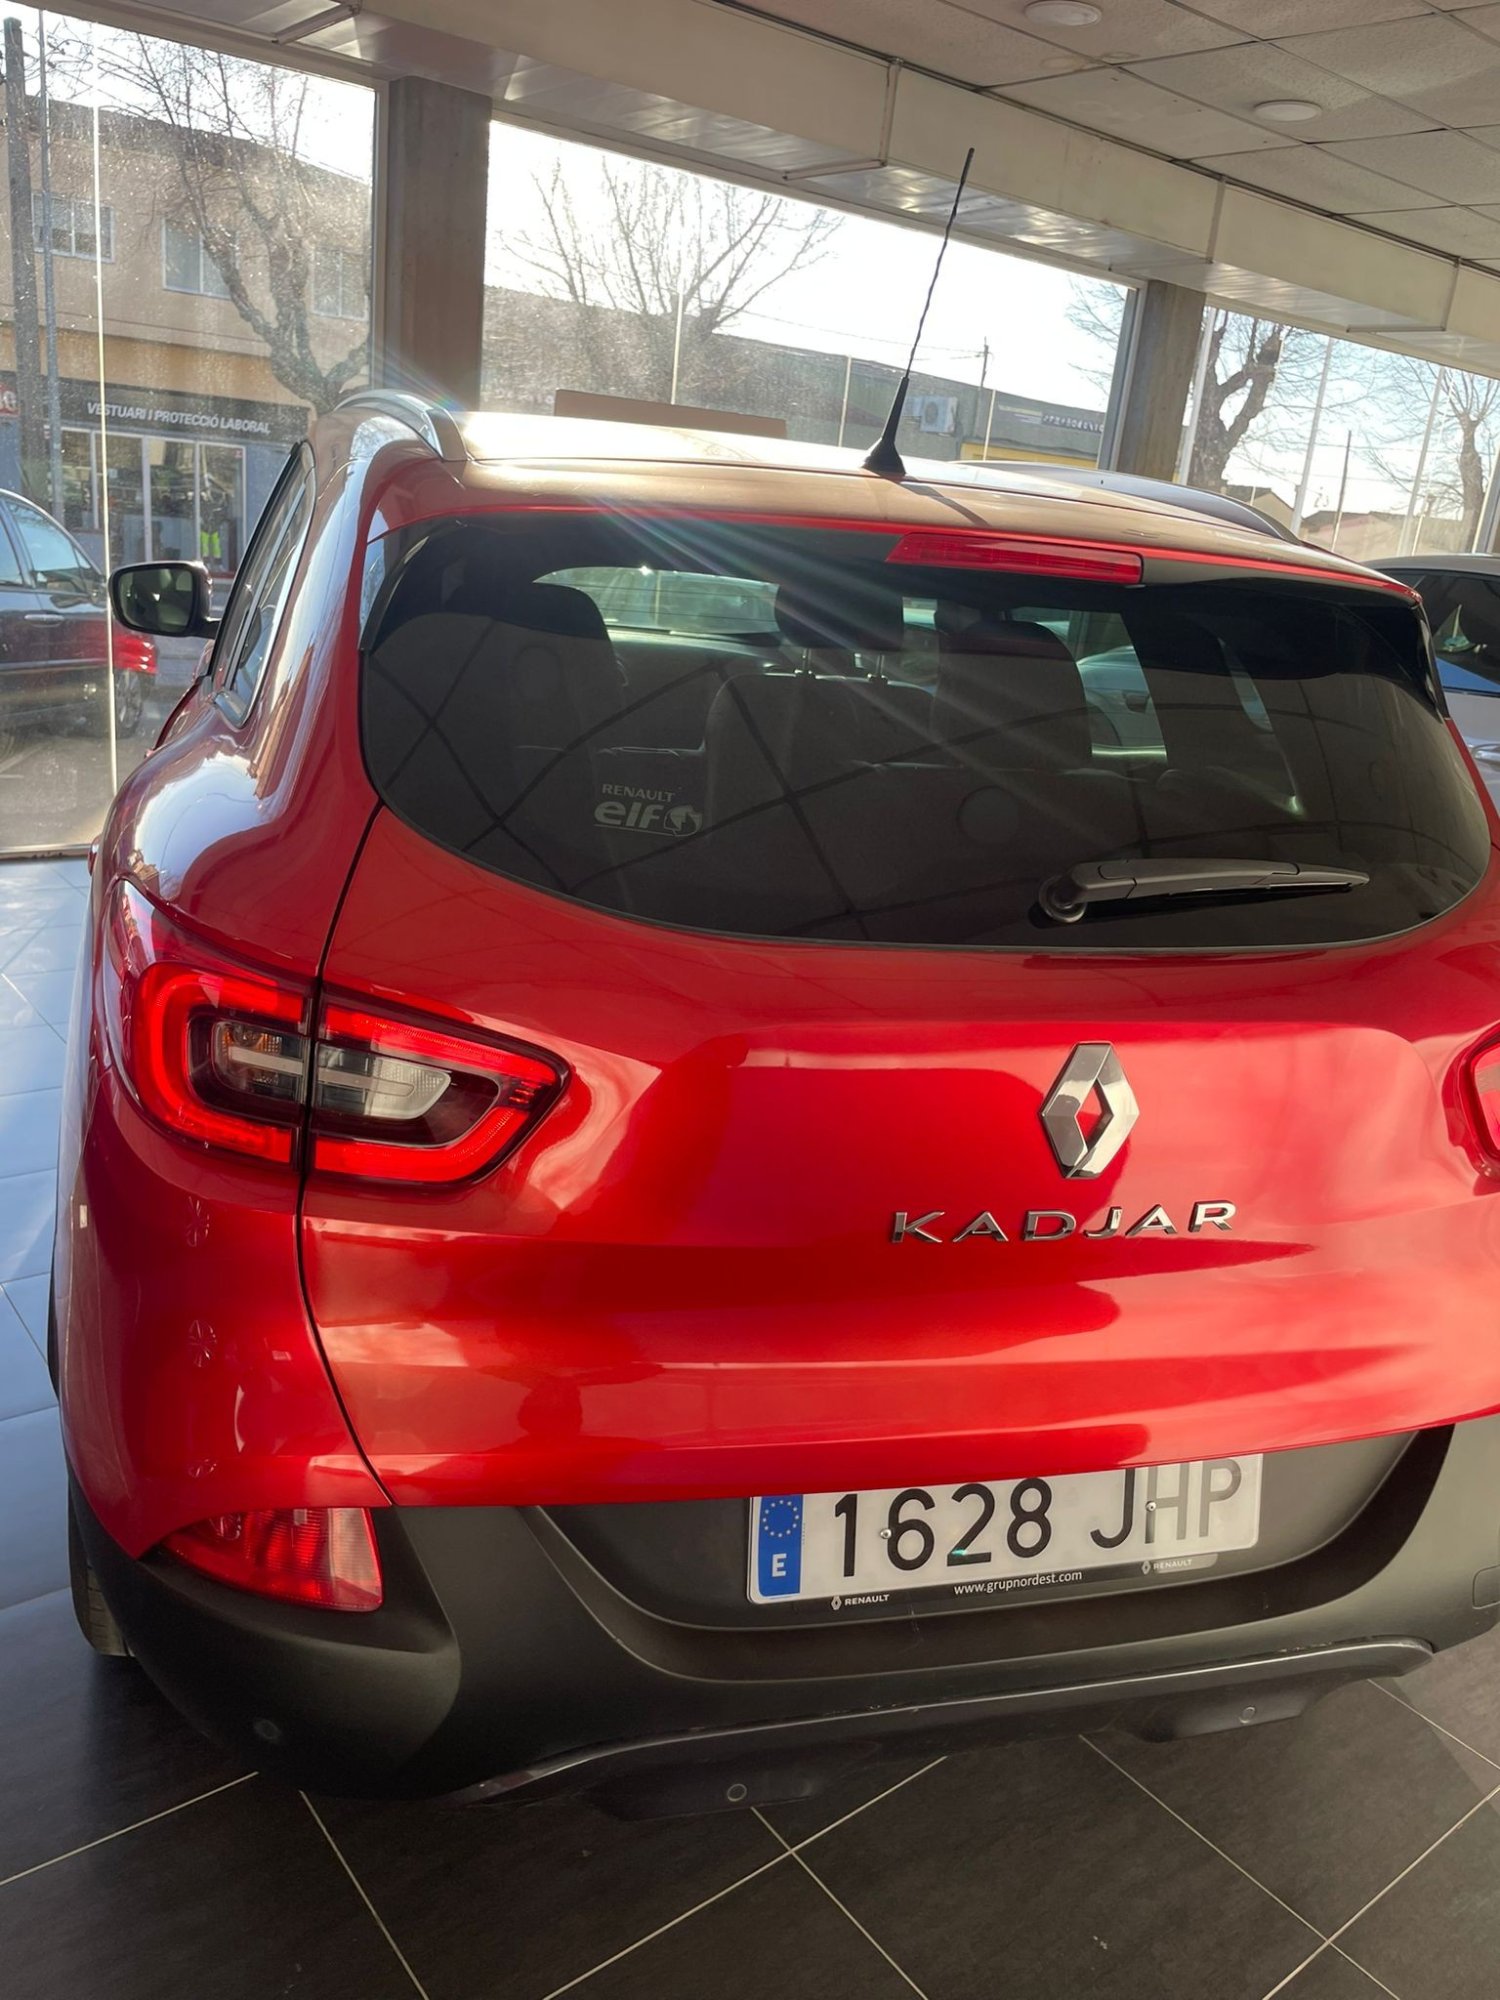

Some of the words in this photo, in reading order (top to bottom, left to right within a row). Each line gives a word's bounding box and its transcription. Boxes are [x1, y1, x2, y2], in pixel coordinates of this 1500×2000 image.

[87, 402, 146, 419] VESTUARI
[154, 410, 218, 427] PROTECCIÓ
[220, 417, 271, 434] LABORAL
[602, 783, 675, 802] RENAULT
[594, 801, 665, 829] elf
[890, 1200, 1237, 1244] KADJAR
[834, 1477, 1053, 1578] 1628
[1090, 1458, 1242, 1549] JHP
[771, 1553, 788, 1578] E
[1153, 1558, 1193, 1570] RENAULT
[953, 1570, 1083, 1596] www.grupnordest.com
[843, 1594, 890, 1607] RENAULT
